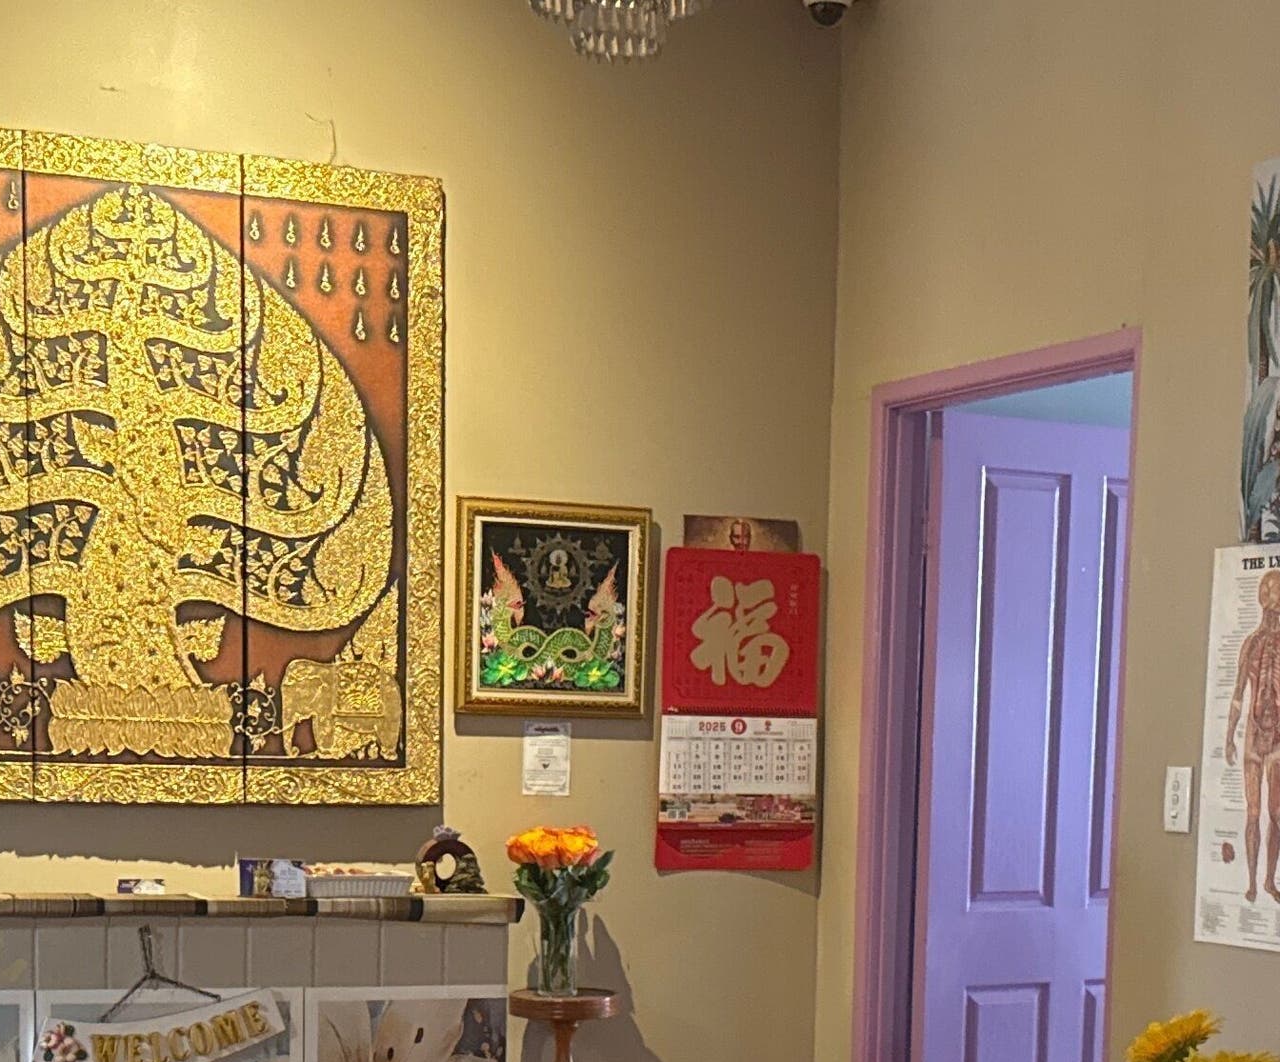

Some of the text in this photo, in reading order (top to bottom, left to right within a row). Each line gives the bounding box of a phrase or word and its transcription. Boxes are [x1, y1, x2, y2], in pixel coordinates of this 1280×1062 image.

[1241, 556, 1266, 570] THE
[690, 575, 791, 688] 福
[698, 721, 727, 732] 2025
